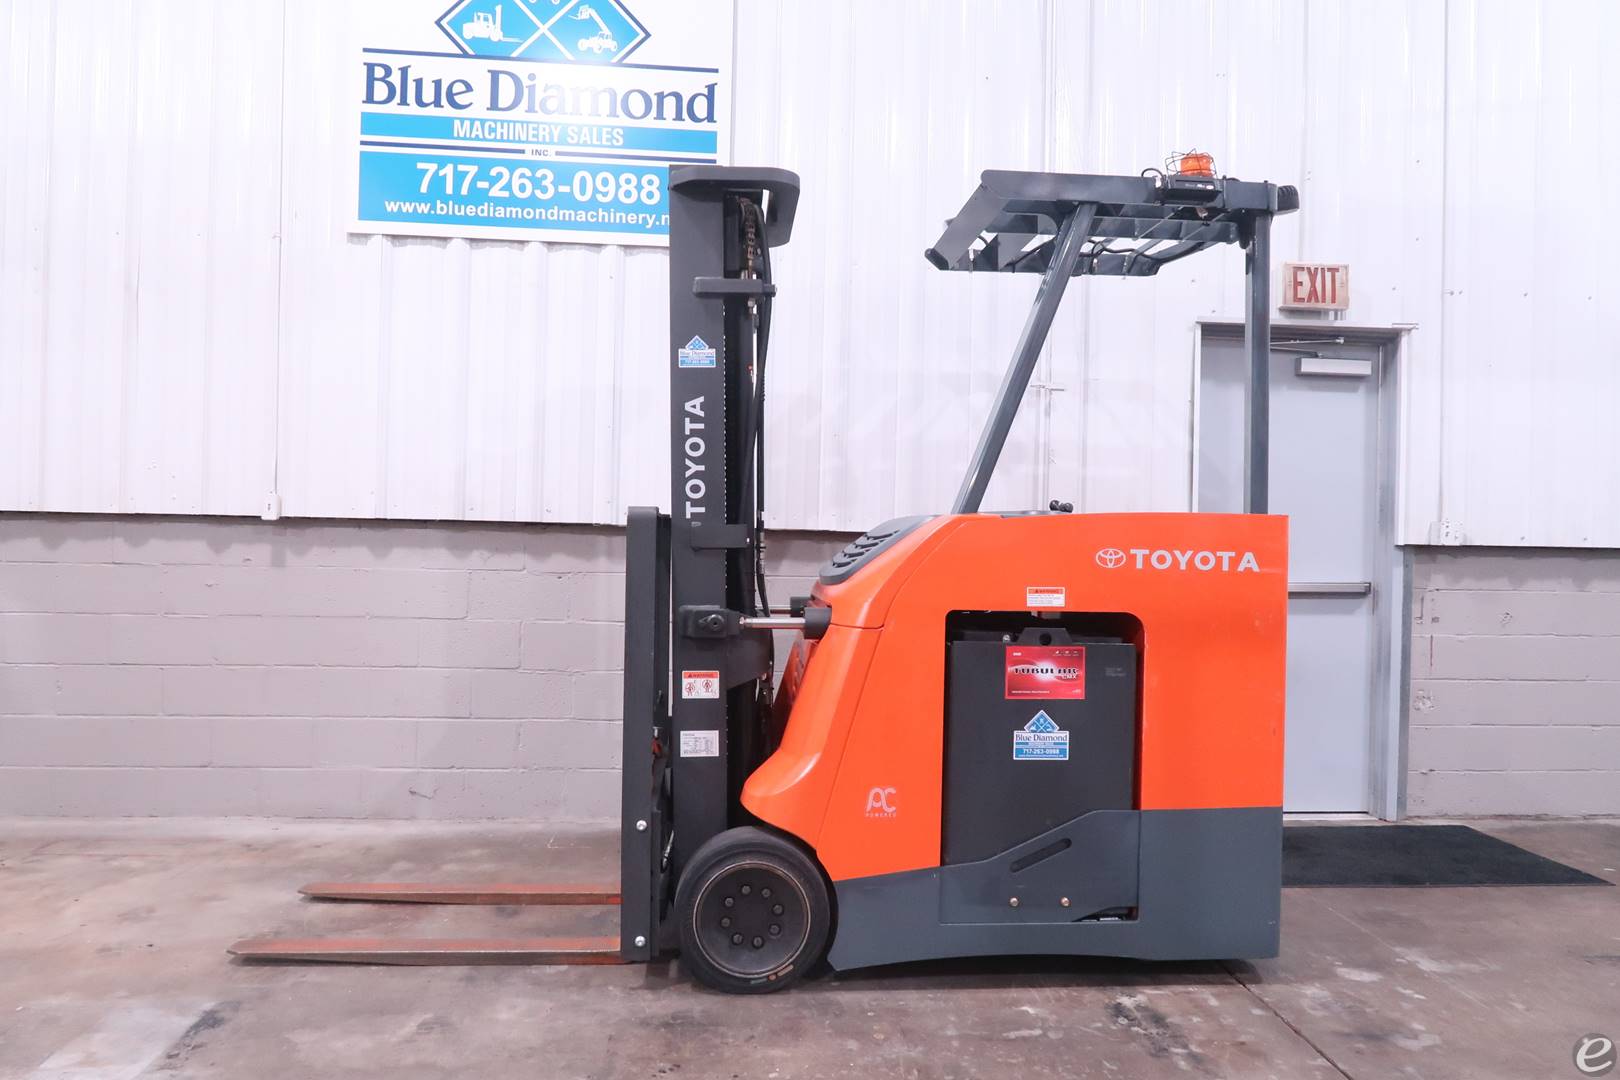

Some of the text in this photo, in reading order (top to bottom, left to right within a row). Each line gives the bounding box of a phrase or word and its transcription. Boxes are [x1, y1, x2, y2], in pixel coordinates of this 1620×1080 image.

[362, 62, 718, 124] Blue Diamond
[453, 119, 624, 146] MACHINERY SALES
[531, 148, 551, 157] INC.
[416, 162, 661, 205] 717-263-0988
[1293, 266, 1340, 304] EXIT
[684, 396, 706, 519] TOYOTA
[1130, 548, 1260, 572] TOYOTA
[1015, 734, 1068, 742] Blue Diamond
[865, 787, 897, 813] AC
